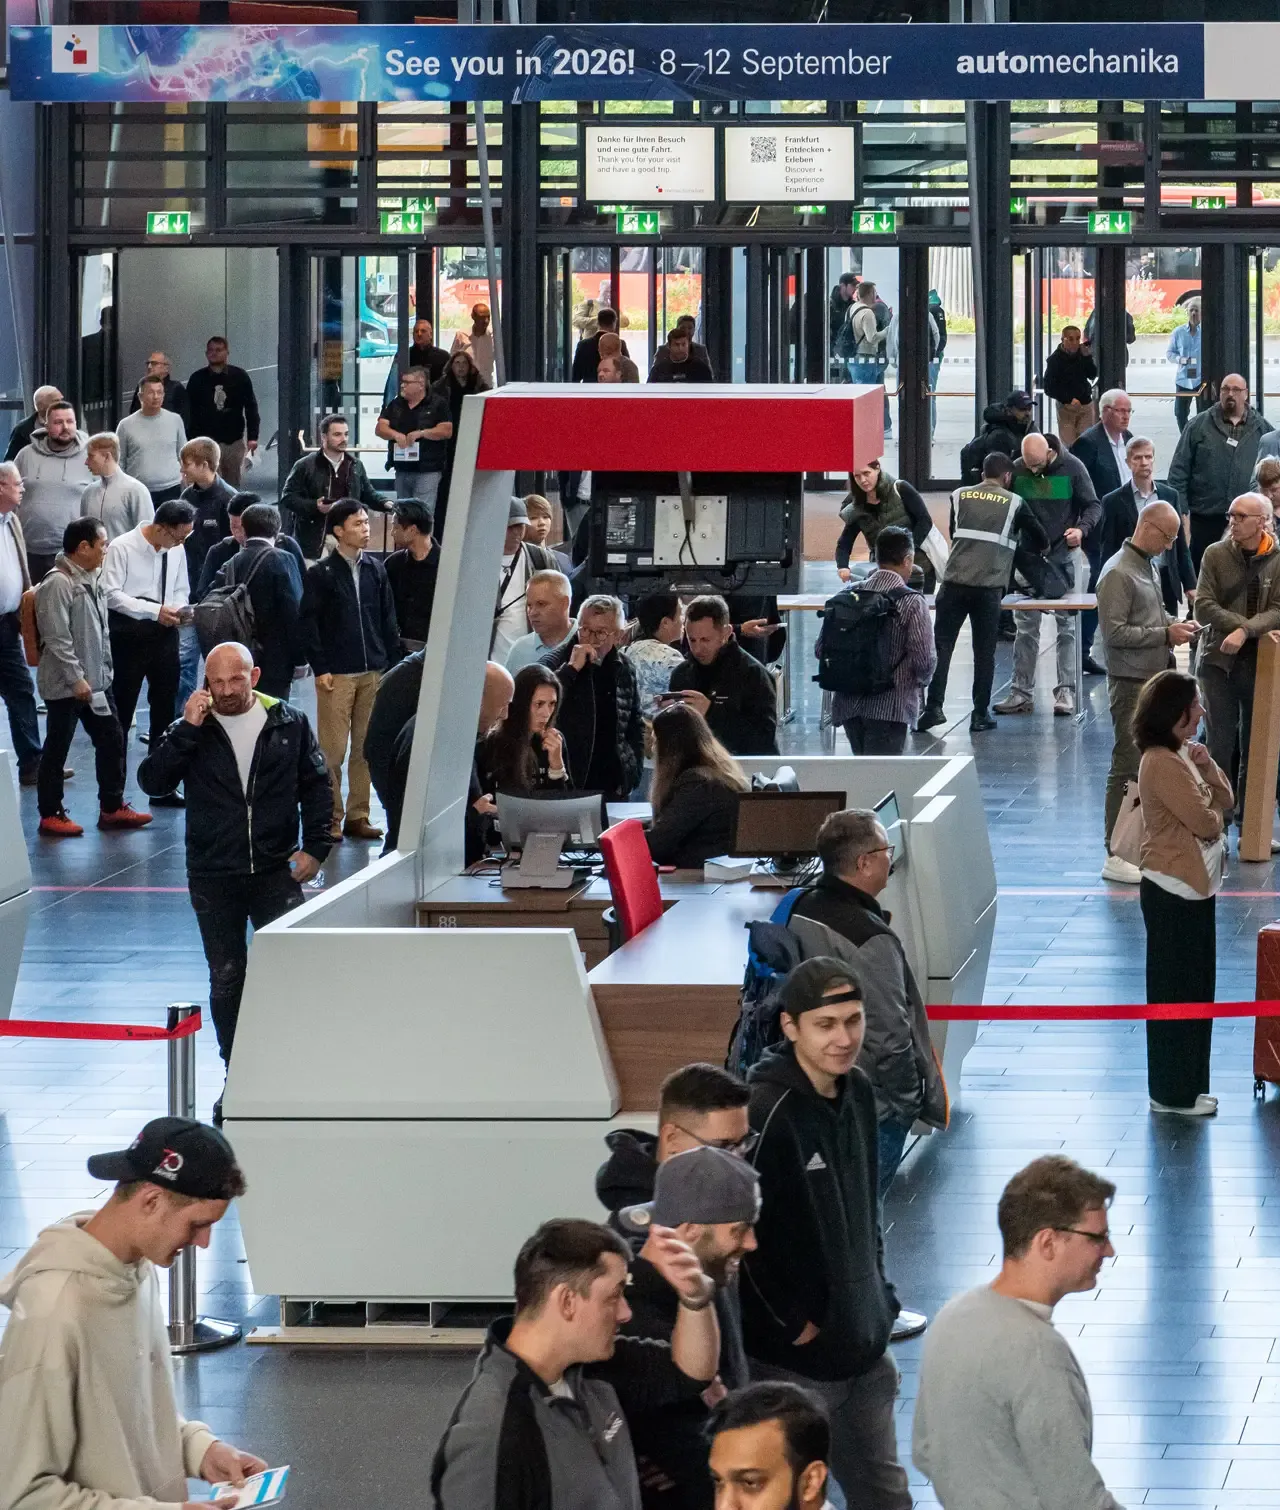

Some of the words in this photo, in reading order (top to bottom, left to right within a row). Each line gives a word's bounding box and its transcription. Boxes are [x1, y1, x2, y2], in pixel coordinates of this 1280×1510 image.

[385, 49, 440, 76] See
[450, 55, 504, 82] you
[516, 49, 542, 75] in
[553, 49, 635, 76] 2026!
[742, 49, 892, 81] September
[956, 48, 1179, 74] automechanika
[597, 135, 621, 143] Danke
[623, 135, 634, 143] für
[636, 135, 656, 143] Ihren
[657, 135, 686, 143] Besuch
[784, 135, 820, 143] Frankfurt
[597, 145, 612, 153] und
[631, 146, 649, 155] gute
[651, 145, 672, 153] Fahrt.
[784, 145, 825, 153] Entdecken
[597, 155, 619, 163] Thank
[636, 155, 646, 163] for
[665, 155, 681, 163] visit
[784, 155, 814, 163] Erleben
[597, 165, 611, 173] and
[612, 165, 630, 173] have
[637, 165, 656, 175] good
[657, 165, 672, 175] trip.
[784, 165, 817, 173] Discover
[784, 175, 825, 184] Experience
[784, 185, 818, 193] Frankfurt
[961, 491, 1009, 504] SECURITY
[438, 915, 457, 928] 88
